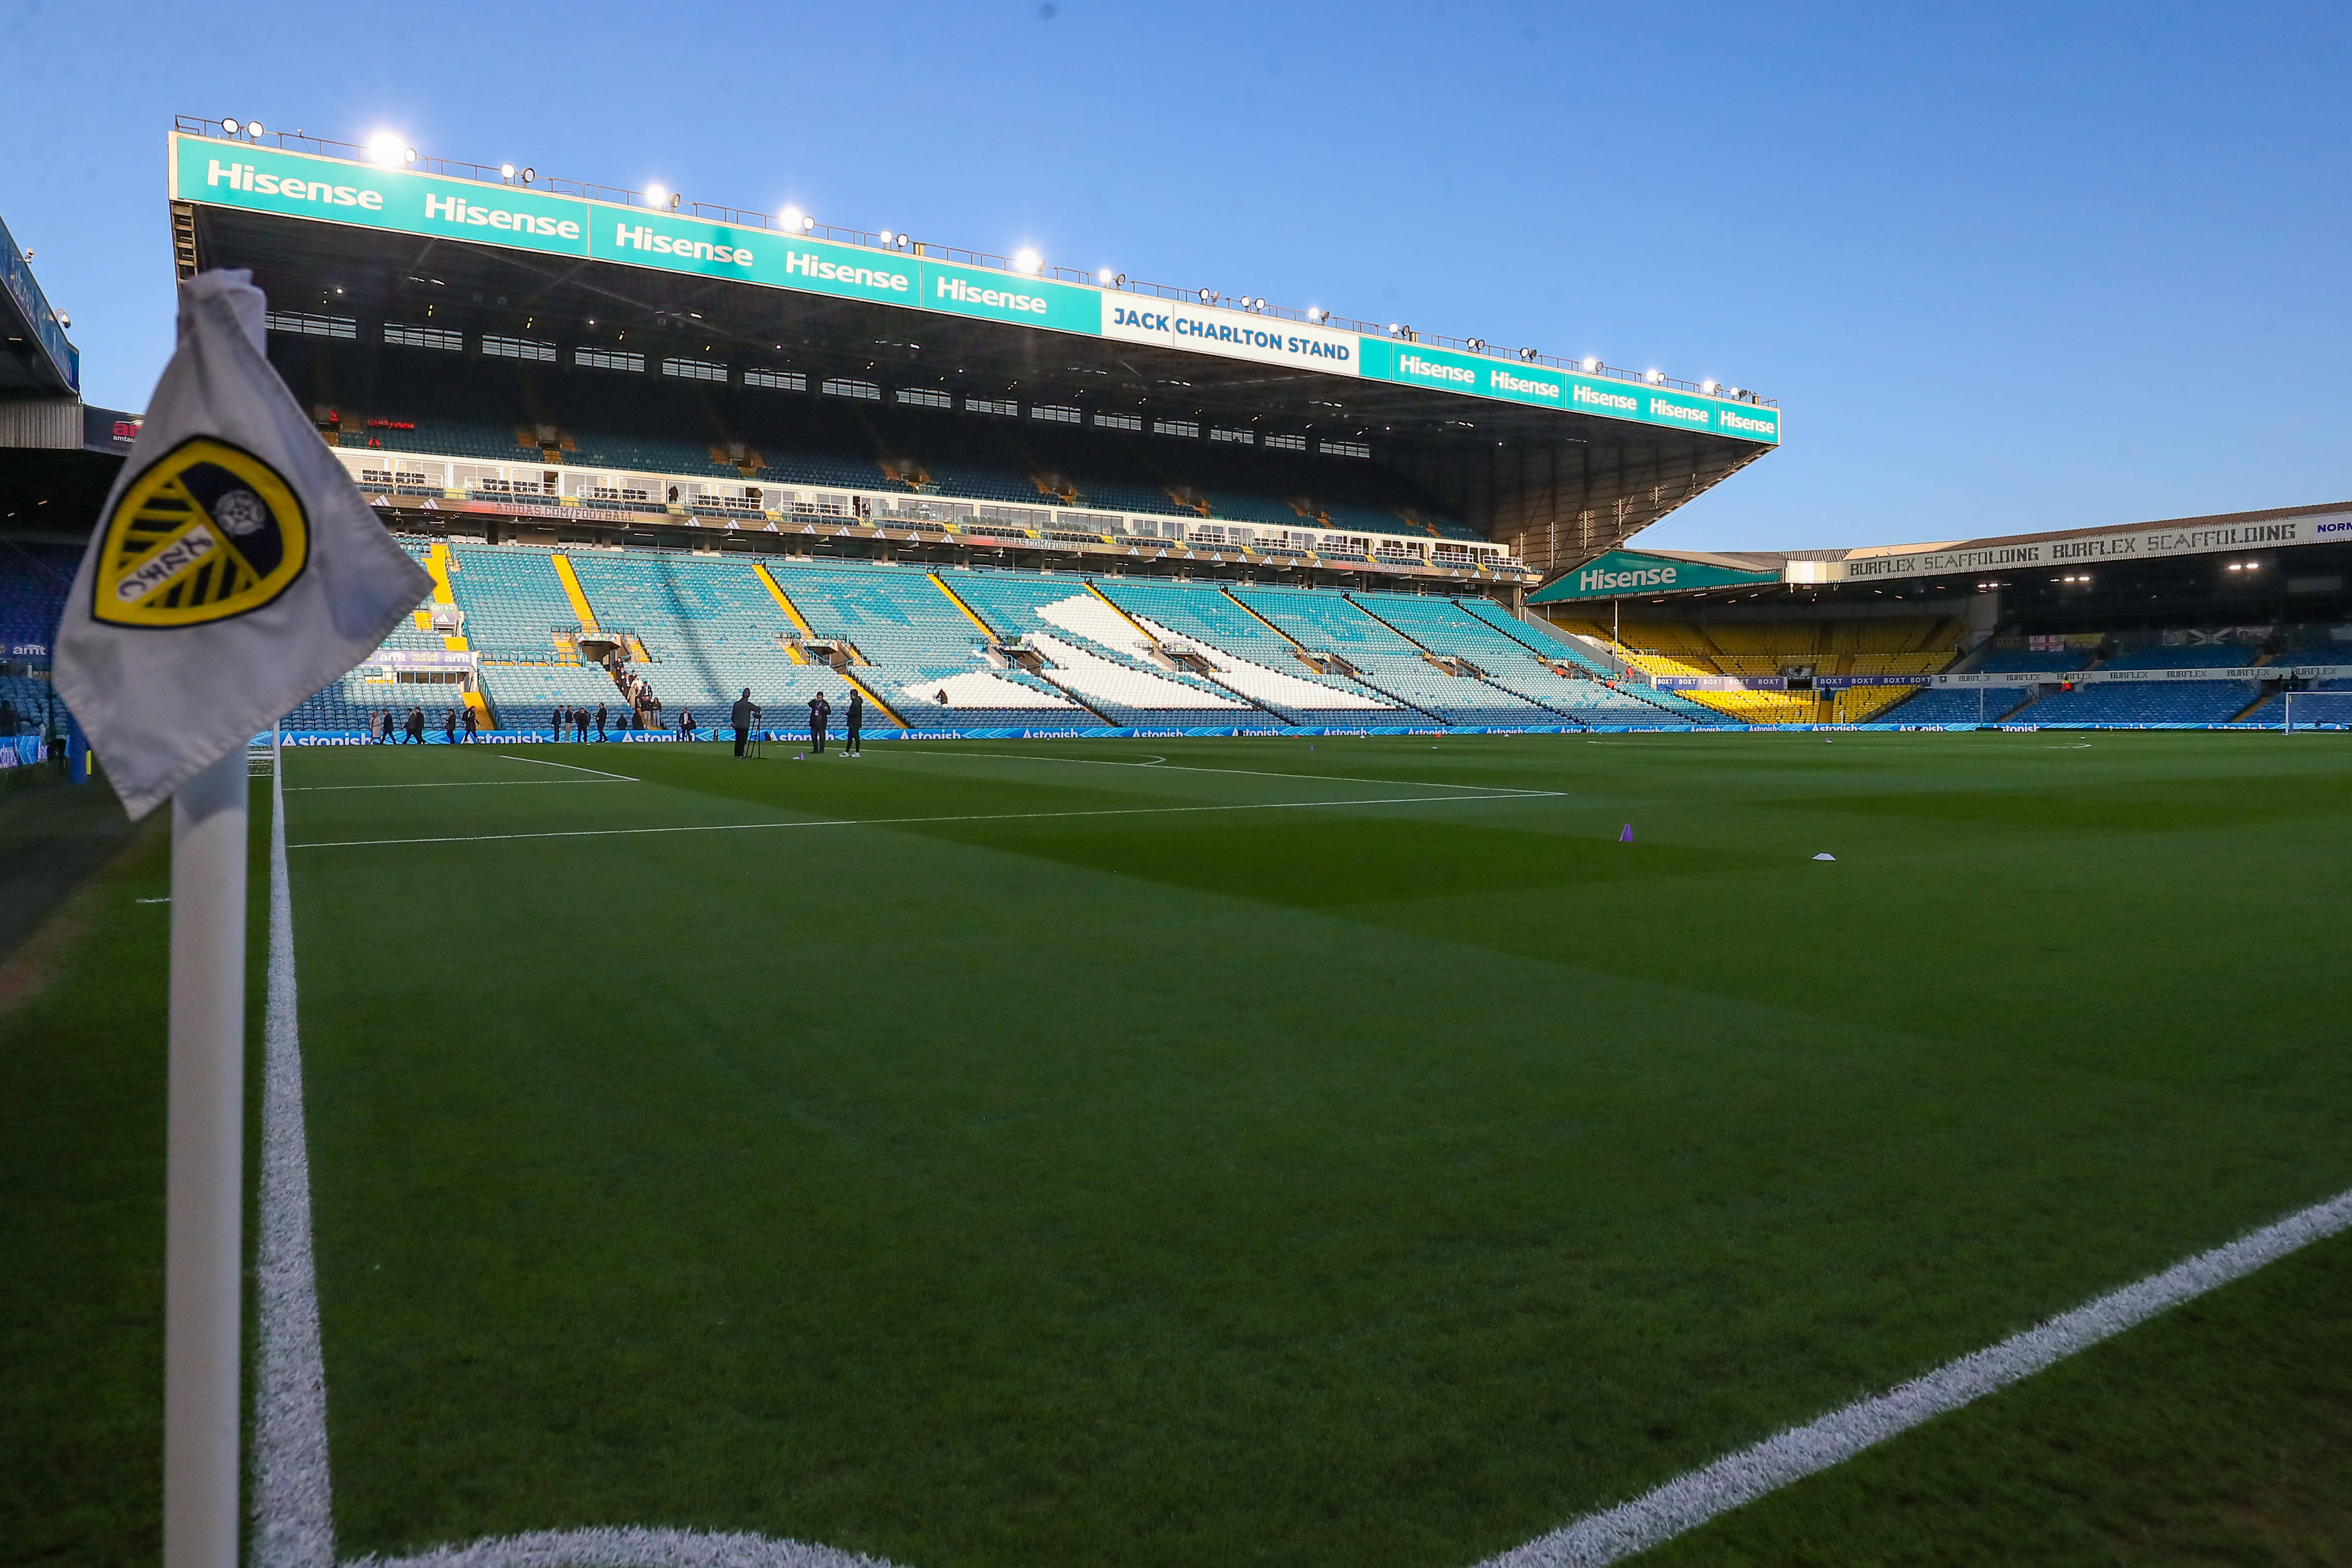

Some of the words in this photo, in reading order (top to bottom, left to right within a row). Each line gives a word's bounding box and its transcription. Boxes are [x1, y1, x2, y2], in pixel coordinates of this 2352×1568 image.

[207, 159, 383, 210] Hisense
[425, 193, 579, 239] Hisense
[616, 223, 753, 266] Hisense
[785, 251, 908, 291] Hisense
[937, 276, 1046, 313] Hisense
[1114, 308, 1169, 332] JACK
[1176, 318, 1282, 350] CHARLTON
[1289, 337, 1350, 361] STAND
[1400, 355, 1475, 384] Hisense
[1491, 370, 1559, 397] Hisense
[1574, 385, 1637, 410] Hisense
[1650, 398, 1708, 423] Hisense
[1720, 410, 1774, 434] Hisense
[495, 503, 634, 521] ADIDAS.COM/FOOTBALL
[994, 537, 1091, 552] ADIDAS.COM/FOOTBALL
[2052, 537, 2136, 559] BURFLEX
[2148, 524, 2296, 551] SCAFFOLDING
[1352, 562, 1424, 574] ADIDAS.COM/FOOTBALL
[1850, 558, 1915, 576] BURFLEX
[1925, 547, 2039, 570] SCAFFOLDING
[1580, 567, 1676, 591] Hisense
[13, 644, 46, 655] amt
[379, 652, 406, 662] amt
[444, 653, 470, 662] amt
[770, 730, 834, 742] Astonh
